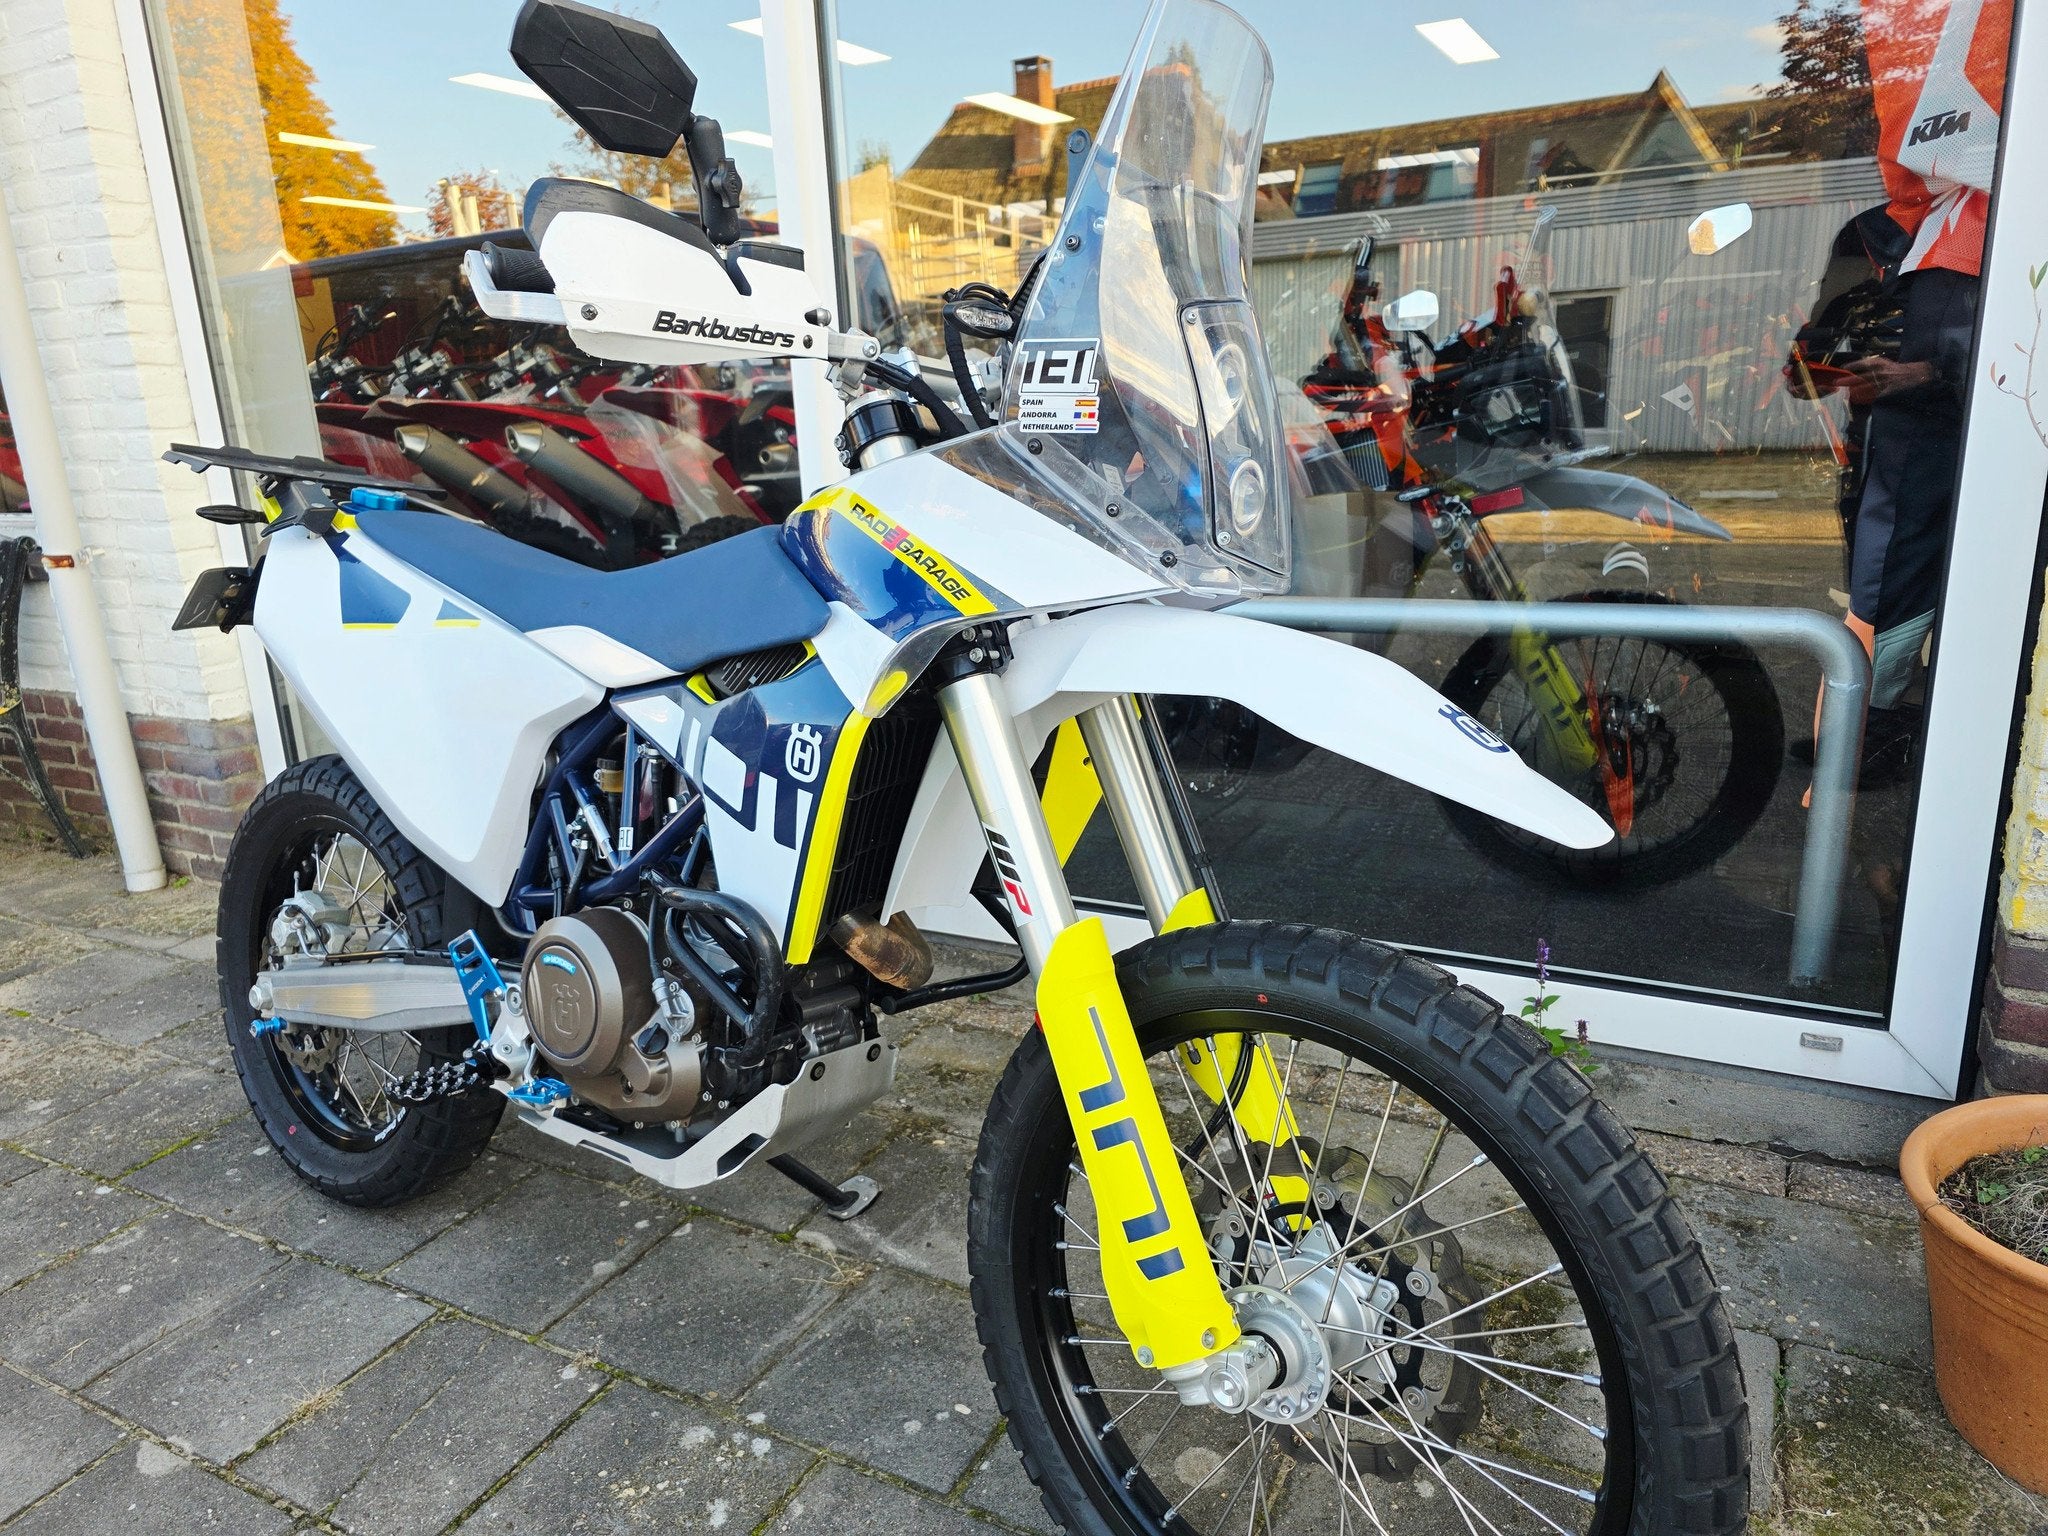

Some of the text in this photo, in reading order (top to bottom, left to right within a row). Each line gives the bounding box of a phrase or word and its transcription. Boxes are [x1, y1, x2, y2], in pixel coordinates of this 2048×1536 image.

[1907, 109, 1972, 148] KTM
[651, 309, 796, 348] Barkbusters
[1021, 398, 1044, 407] SPAIN
[1020, 411, 1058, 419] ANDORRA
[1022, 423, 1074, 431] NETHERLANDS
